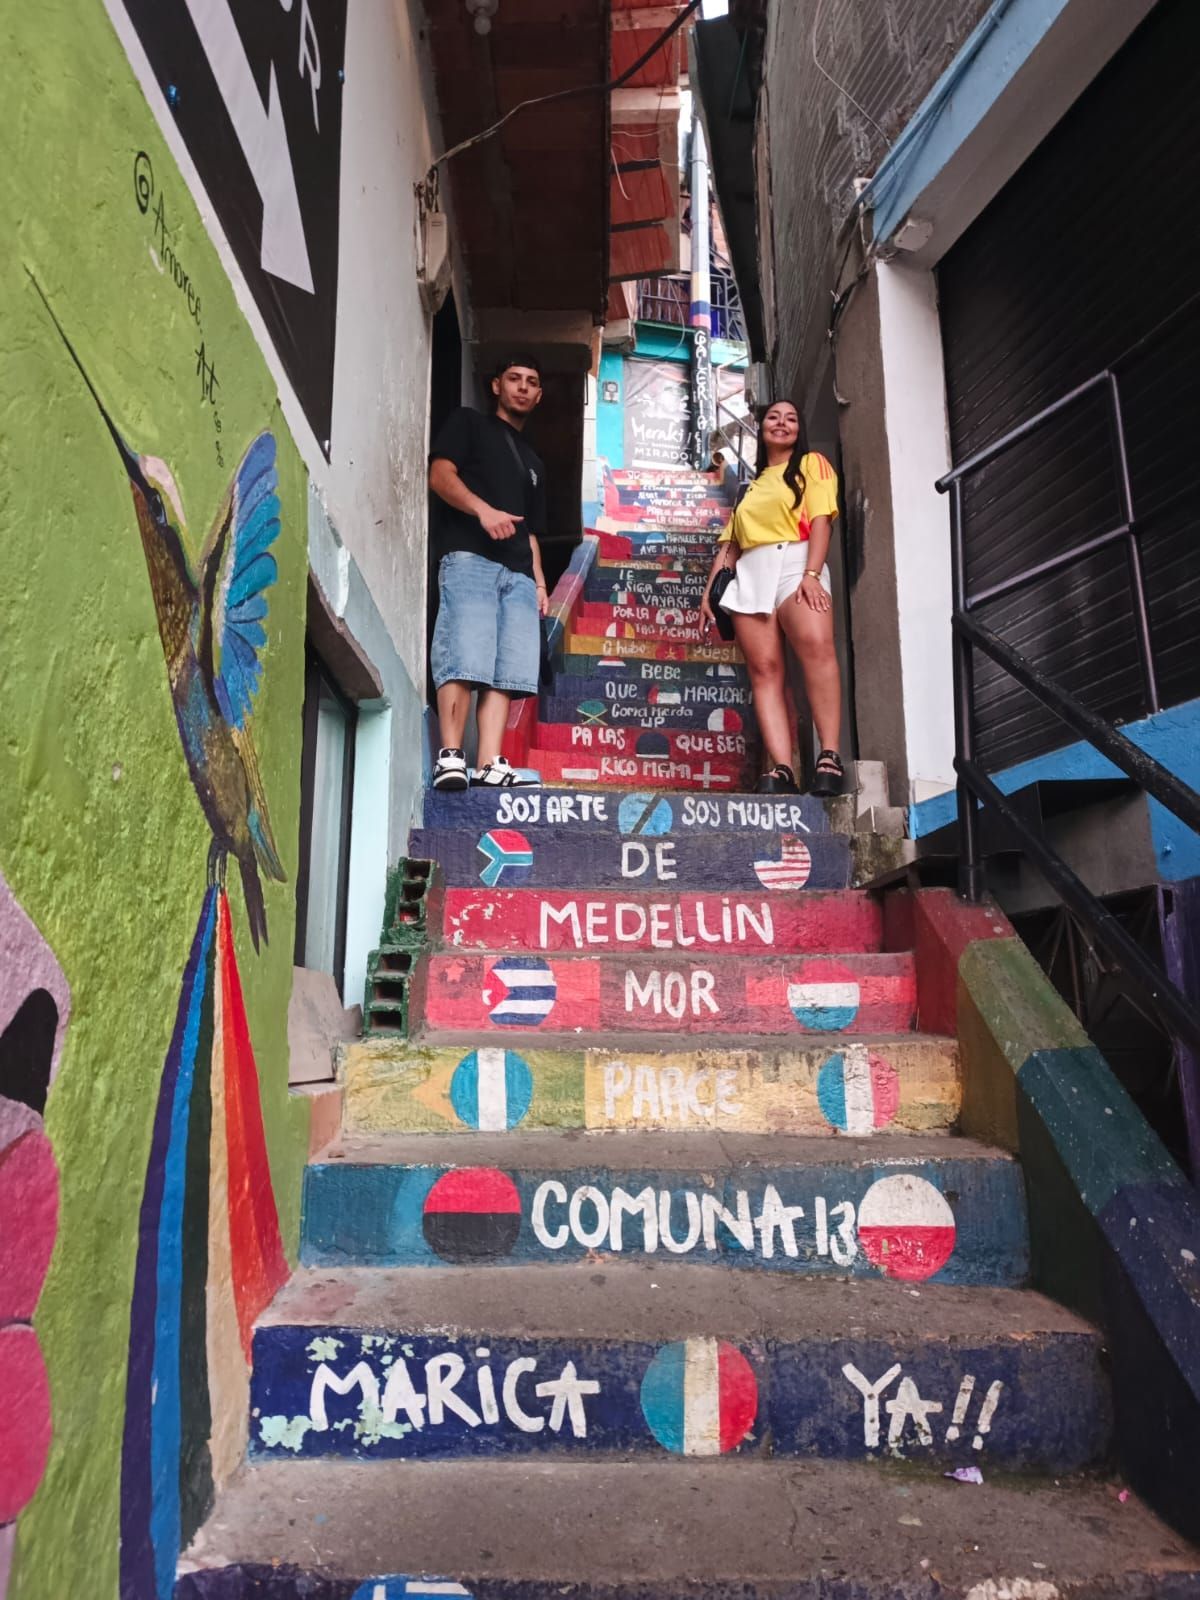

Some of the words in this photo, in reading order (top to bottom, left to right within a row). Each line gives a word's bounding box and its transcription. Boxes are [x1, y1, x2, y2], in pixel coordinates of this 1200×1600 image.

[632, 416, 684, 443] Meraki
[634, 447, 692, 462] MIRADO
[640, 545, 657, 555] AVE
[684, 574, 708, 585] GUS
[612, 606, 635, 618] POR
[636, 608, 650, 619] LA
[641, 594, 691, 609] VAYASE
[641, 663, 681, 680] BeBe
[572, 726, 593, 746] PA
[598, 728, 626, 750] LAS
[675, 734, 715, 755] QUE
[717, 735, 746, 755] SEA
[601, 756, 638, 776] RiCO
[496, 793, 541, 824] SOY
[545, 794, 608, 824] ARTE
[681, 799, 724, 826] SOY
[728, 800, 811, 832] MUJER
[620, 841, 678, 880] DE
[539, 897, 775, 949] MEDELLiN
[624, 969, 720, 1018] MOR
[603, 1060, 743, 1121] PARCE
[531, 1180, 805, 1259] COMUNA
[814, 1196, 857, 1267] 13
[309, 1346, 600, 1438] MARiCA
[841, 1362, 1005, 1451] YA!!
